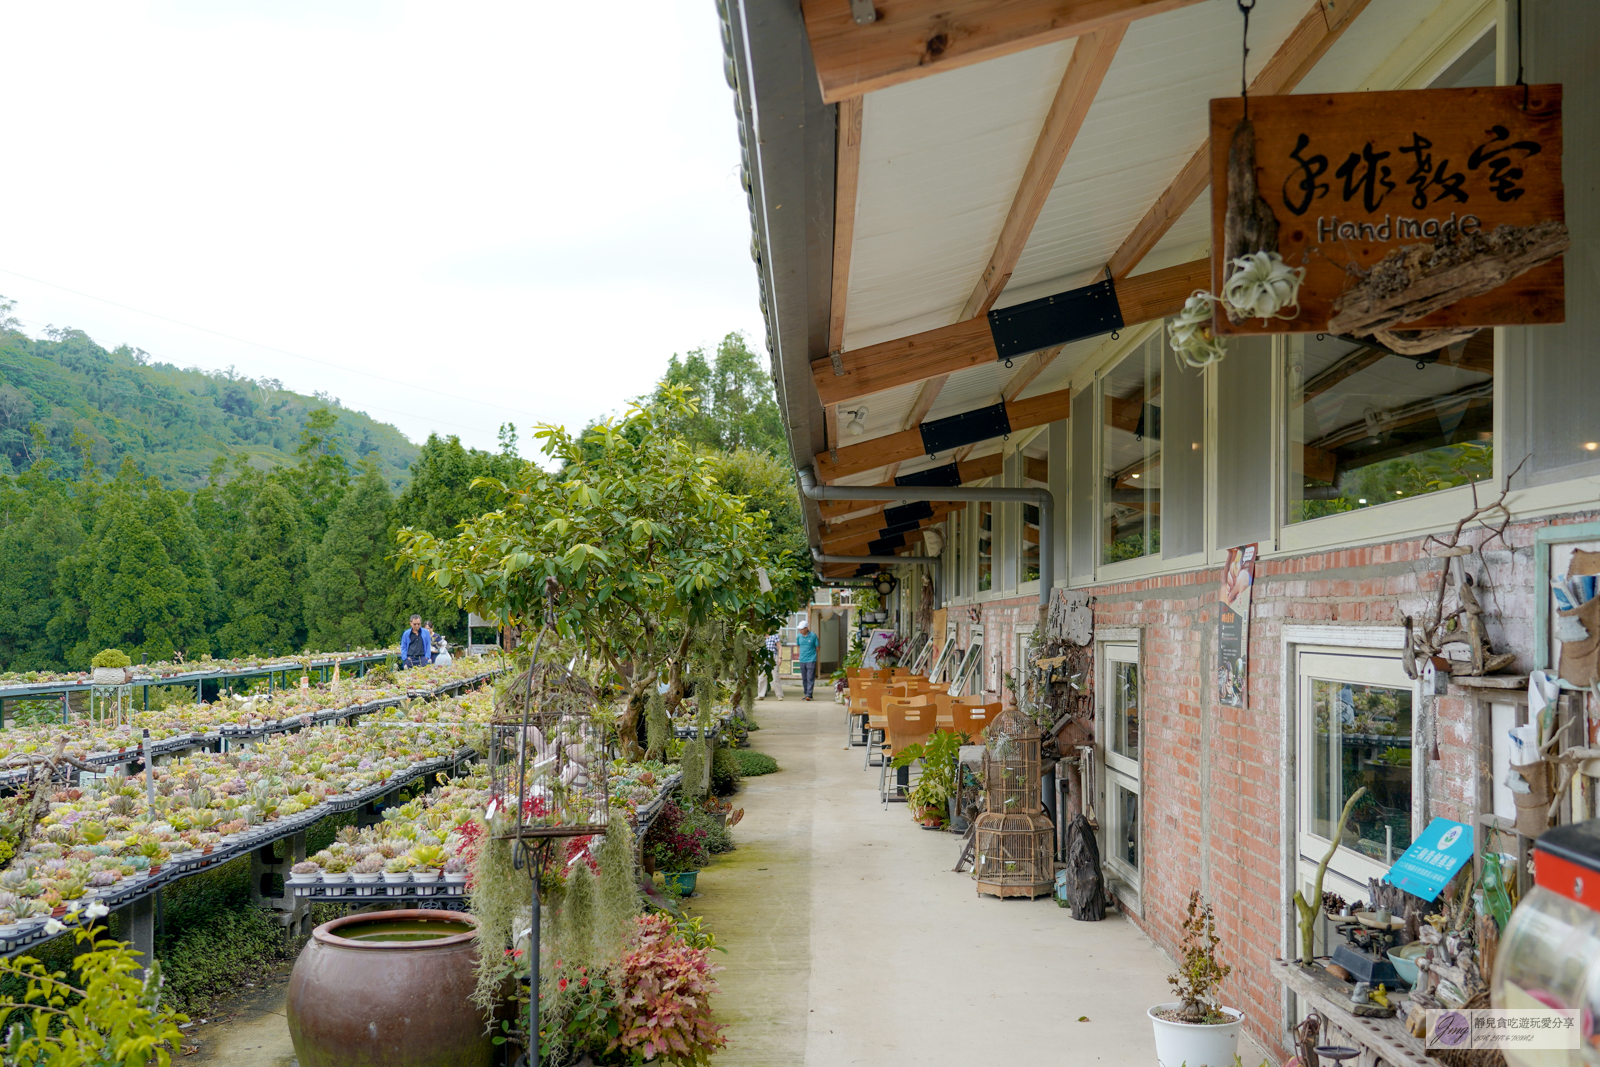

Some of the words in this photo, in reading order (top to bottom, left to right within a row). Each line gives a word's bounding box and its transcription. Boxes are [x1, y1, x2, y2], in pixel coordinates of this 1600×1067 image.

[1282, 125, 1542, 216] 手作教室
[1317, 211, 1482, 243] Handmade
